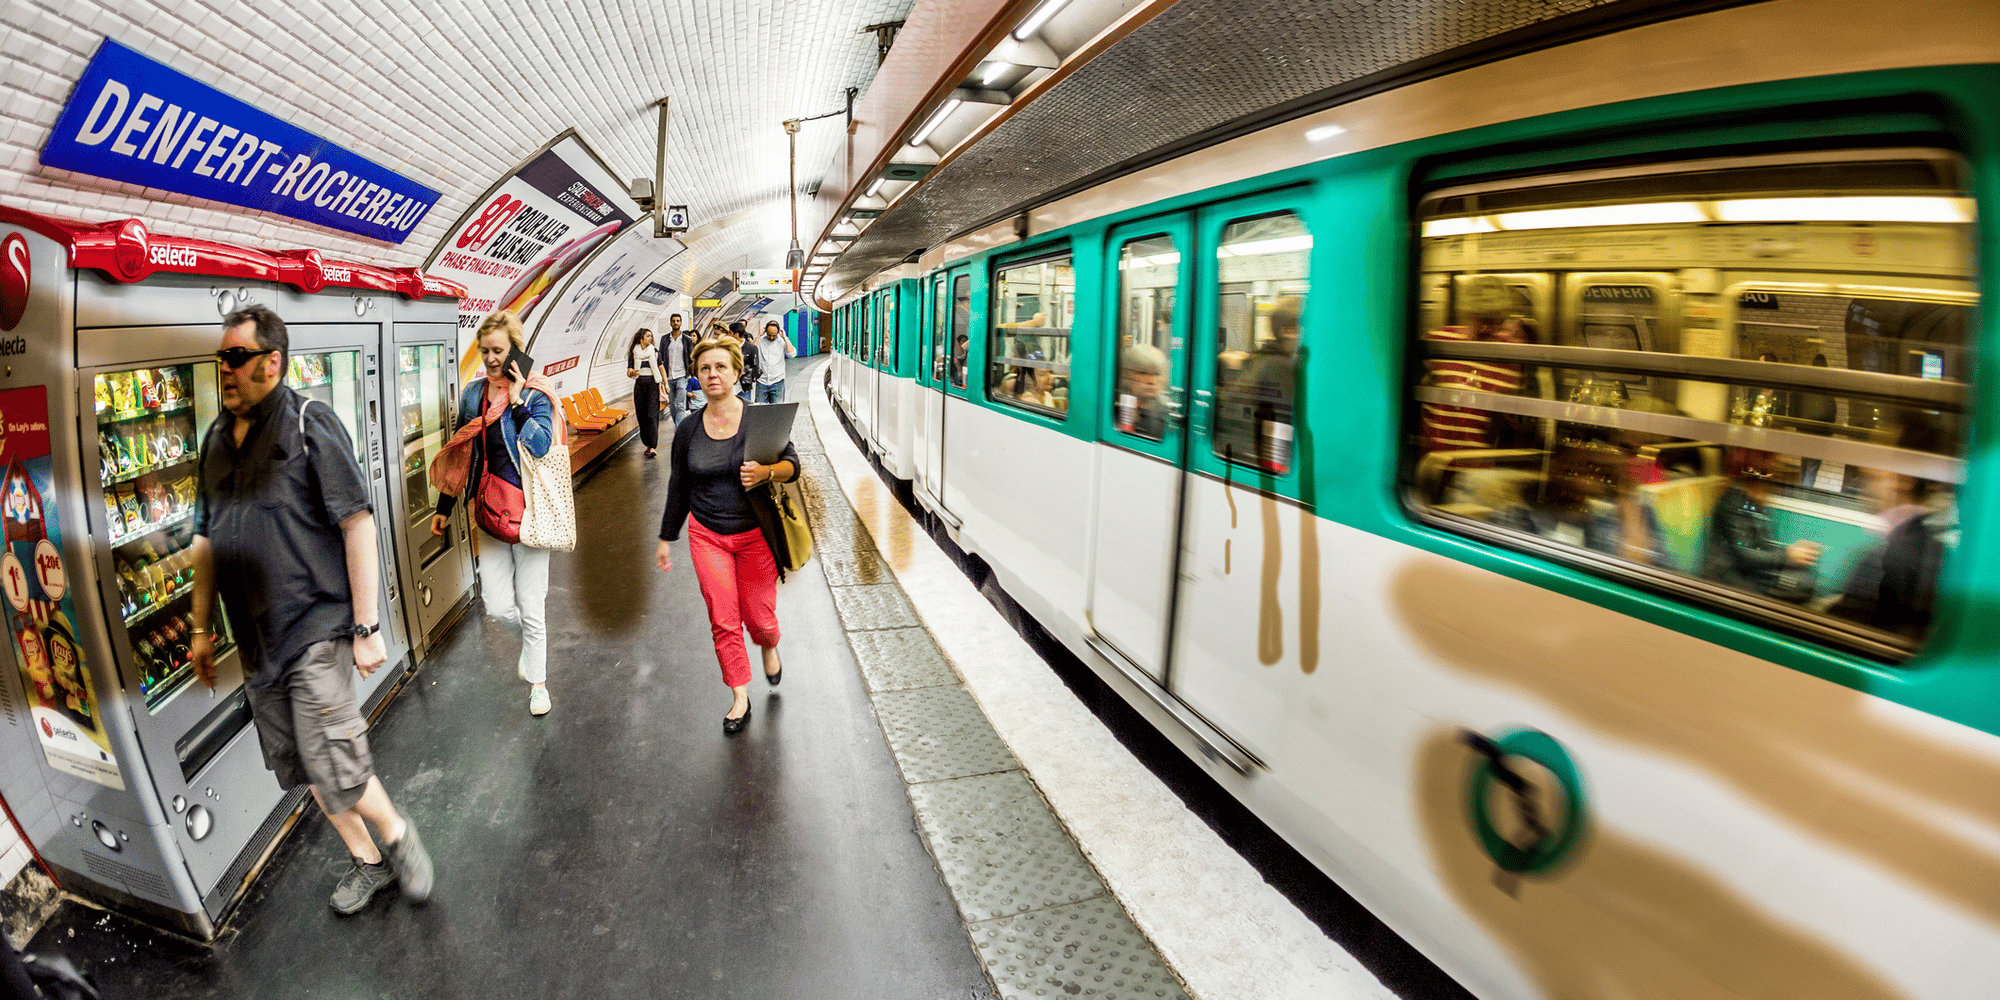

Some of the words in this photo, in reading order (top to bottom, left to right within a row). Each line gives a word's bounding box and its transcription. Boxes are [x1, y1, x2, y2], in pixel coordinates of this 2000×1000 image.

[75, 78, 428, 232] DENFERT-ROCHEREAU
[508, 206, 549, 239] POUR
[536, 217, 570, 246] ALLER
[149, 243, 197, 267] selecta
[484, 231, 522, 263] PLUS
[508, 236, 544, 266] HAUT
[322, 266, 351, 282] selecta
[438, 251, 472, 271] PHASE
[464, 257, 496, 276] FINALE
[488, 262, 504, 277] DU
[498, 264, 515, 279] TOP
[467, 314, 480, 328] 92
[0, 335, 26, 357] lecta
[53, 727, 78, 742] selecta
